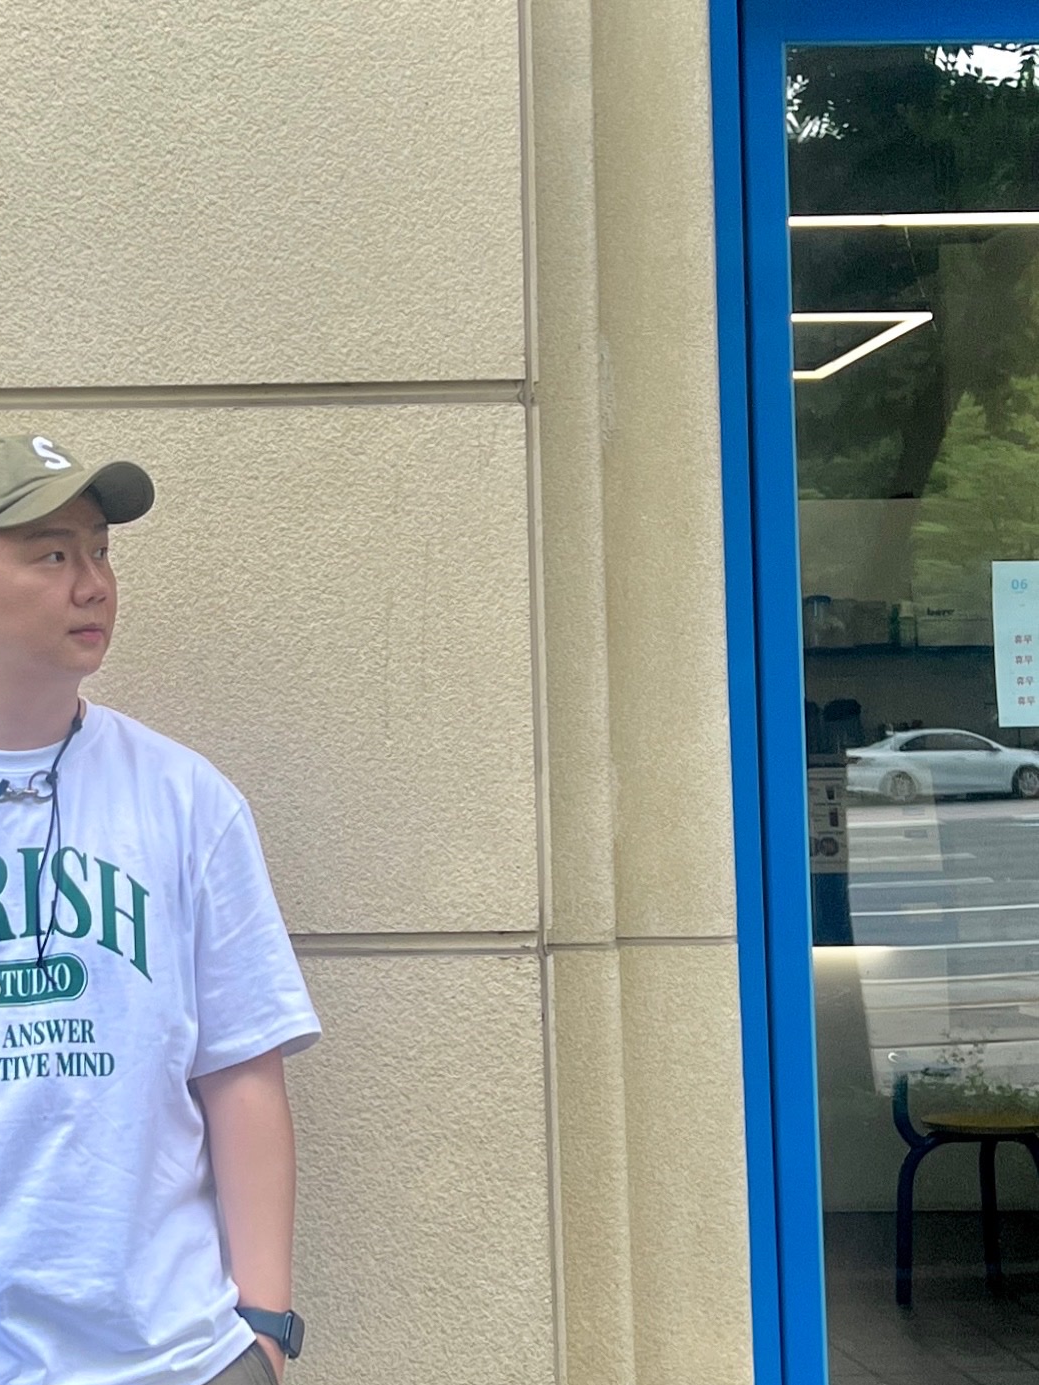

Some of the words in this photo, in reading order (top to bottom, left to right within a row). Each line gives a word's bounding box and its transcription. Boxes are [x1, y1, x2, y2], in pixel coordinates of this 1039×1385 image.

[32, 436, 72, 470] S
[2, 1019, 96, 1049] ANSWER
[56, 1052, 115, 1078] MIND
